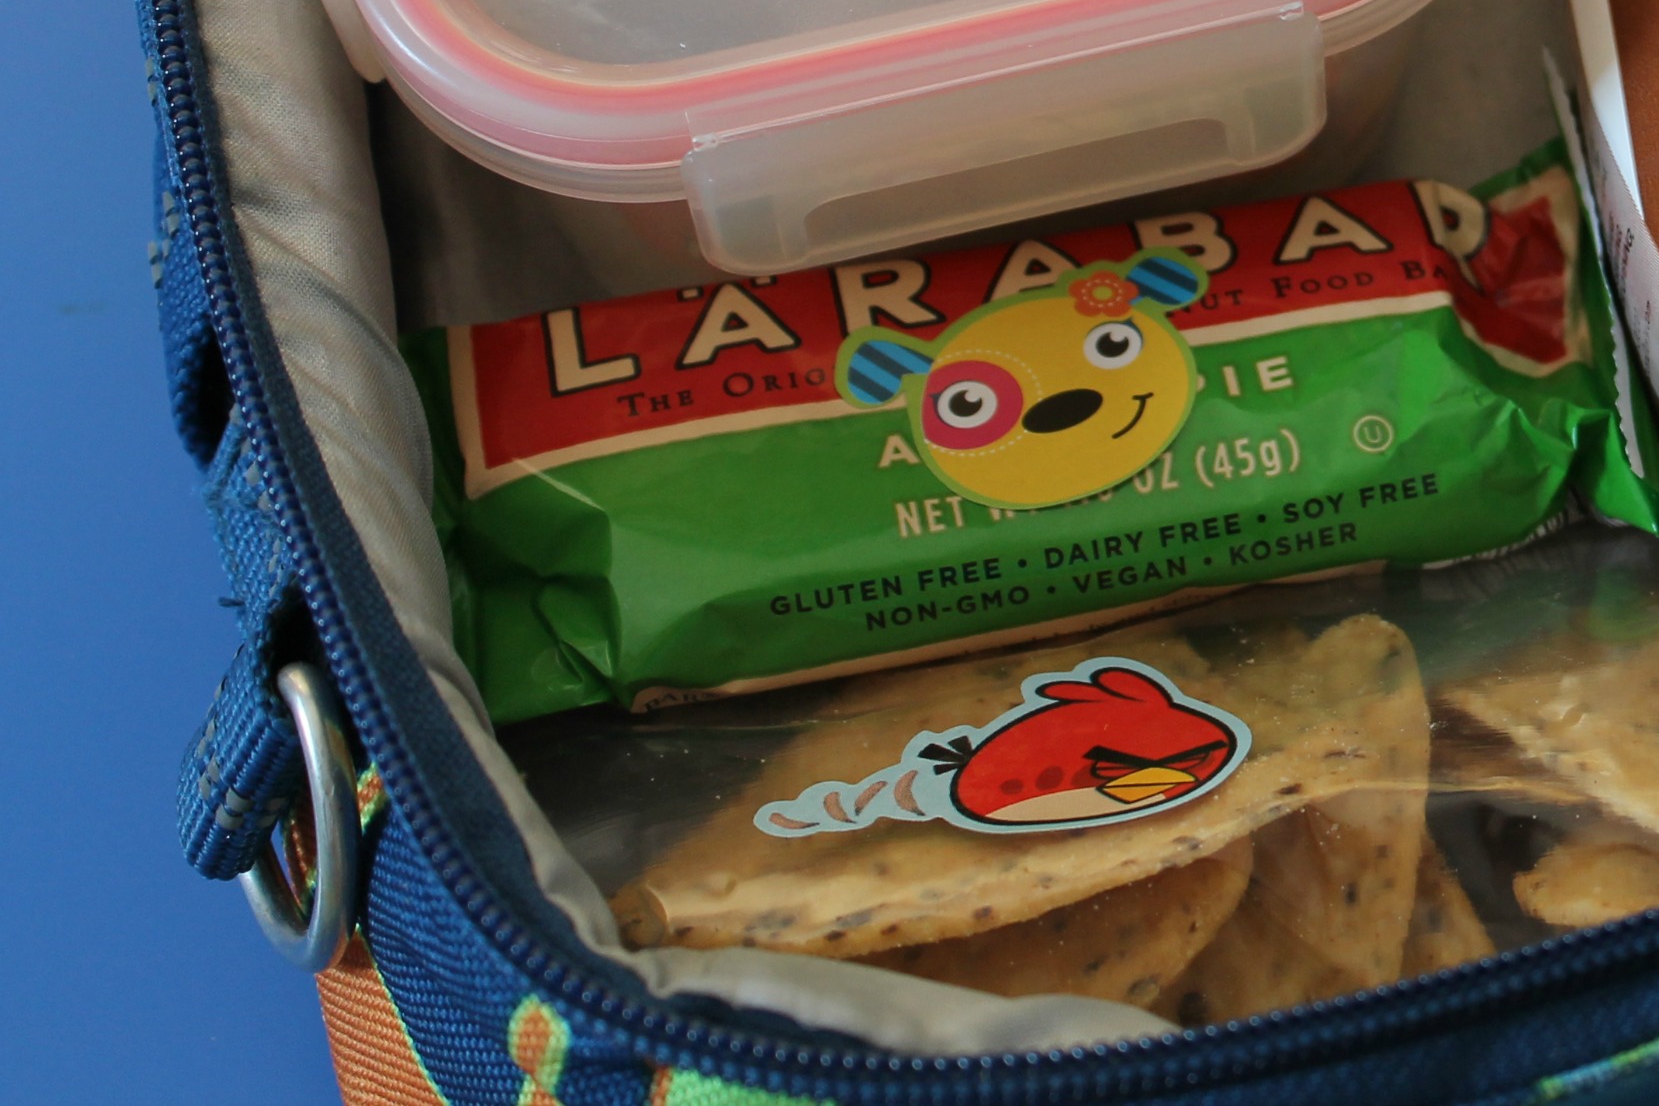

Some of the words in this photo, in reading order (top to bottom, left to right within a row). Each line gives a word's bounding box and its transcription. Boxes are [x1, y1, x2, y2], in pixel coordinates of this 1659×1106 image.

[1195, 428, 1301, 488] (45g)
[769, 576, 903, 616] GLUTEN
[918, 558, 1002, 592] FREE
[1044, 531, 1144, 569] DAIRY
[1159, 513, 1242, 549] FREE
[1282, 493, 1345, 524] SOY
[1359, 473, 1439, 508] FREE
[895, 496, 967, 538] NET
[865, 586, 1030, 632] NON-GMO
[1072, 556, 1187, 594] VEGAN
[1229, 522, 1358, 567] KOSHER
